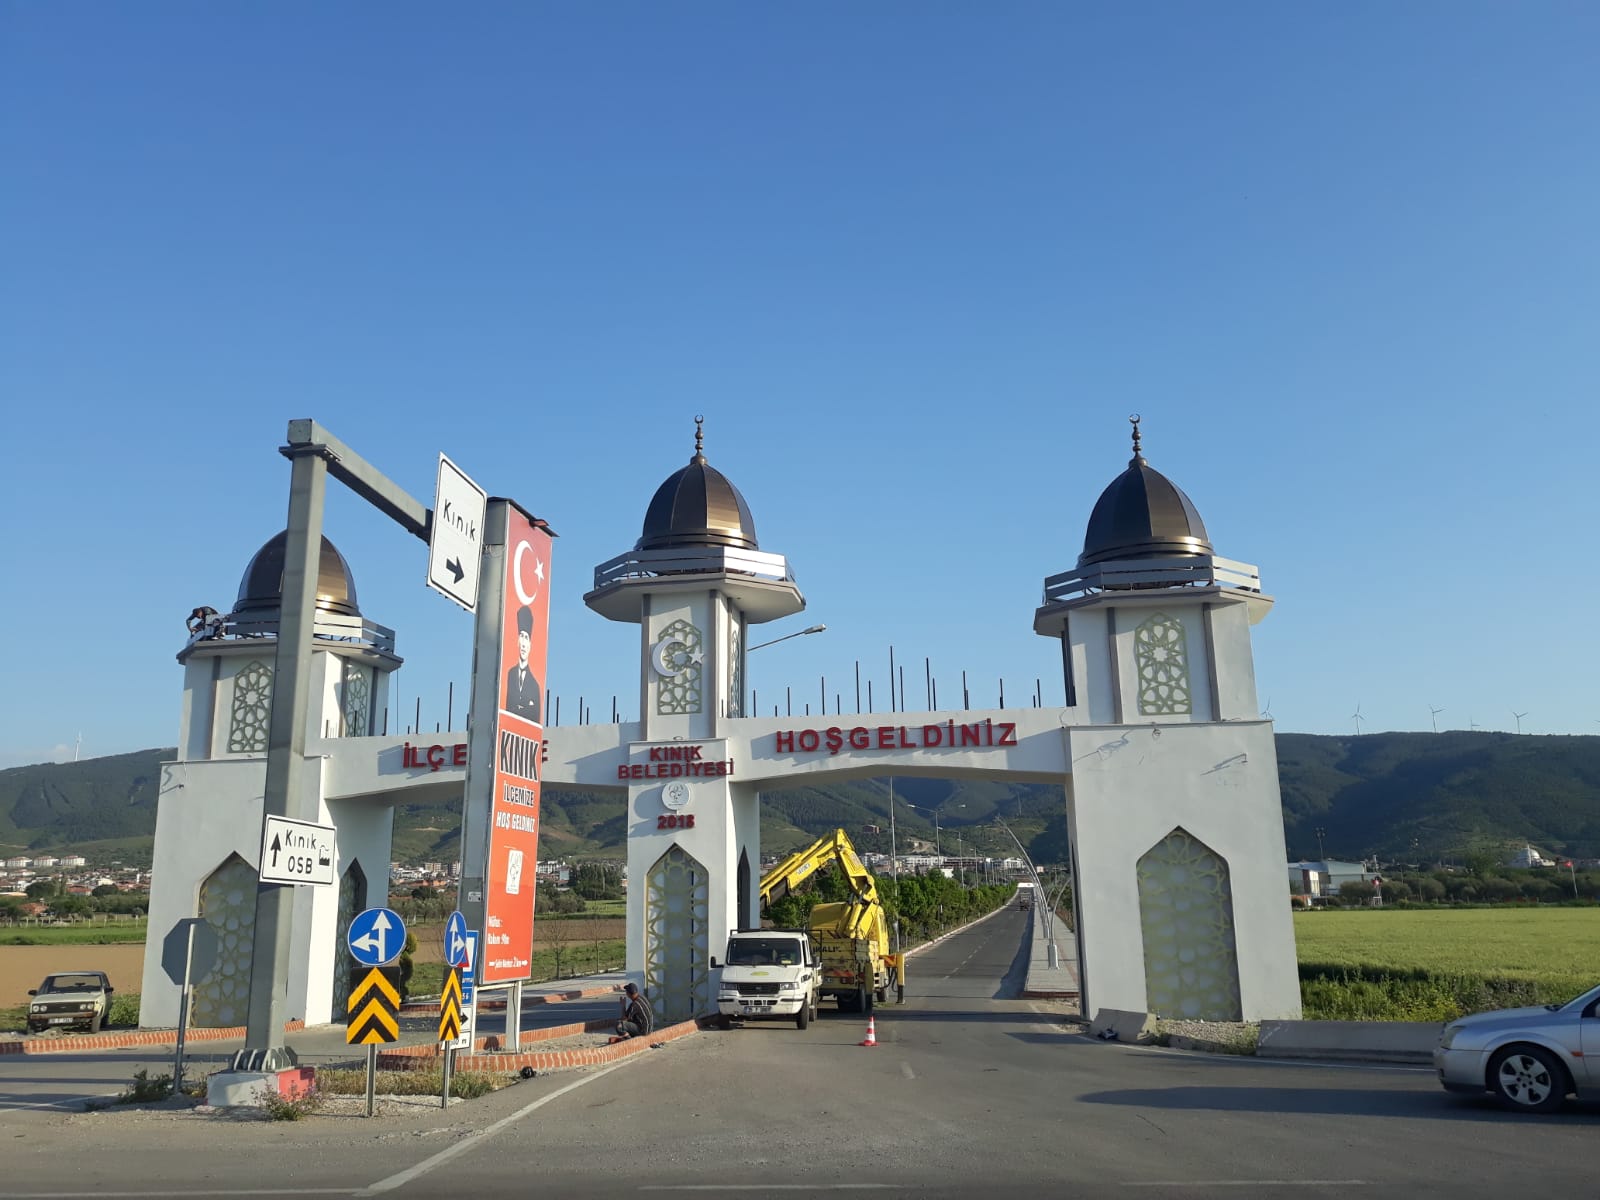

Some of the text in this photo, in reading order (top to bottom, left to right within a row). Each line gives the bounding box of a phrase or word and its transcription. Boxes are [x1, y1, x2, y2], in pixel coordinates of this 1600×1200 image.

[443, 499, 476, 541] Kınık
[776, 718, 1018, 755] HOŞGELDİNİZ
[500, 730, 539, 781] KINIK
[650, 746, 703, 761] KINIK
[618, 758, 734, 779] BELEDİYESİ
[285, 829, 317, 850] Kınık
[287, 855, 313, 875] OSB
